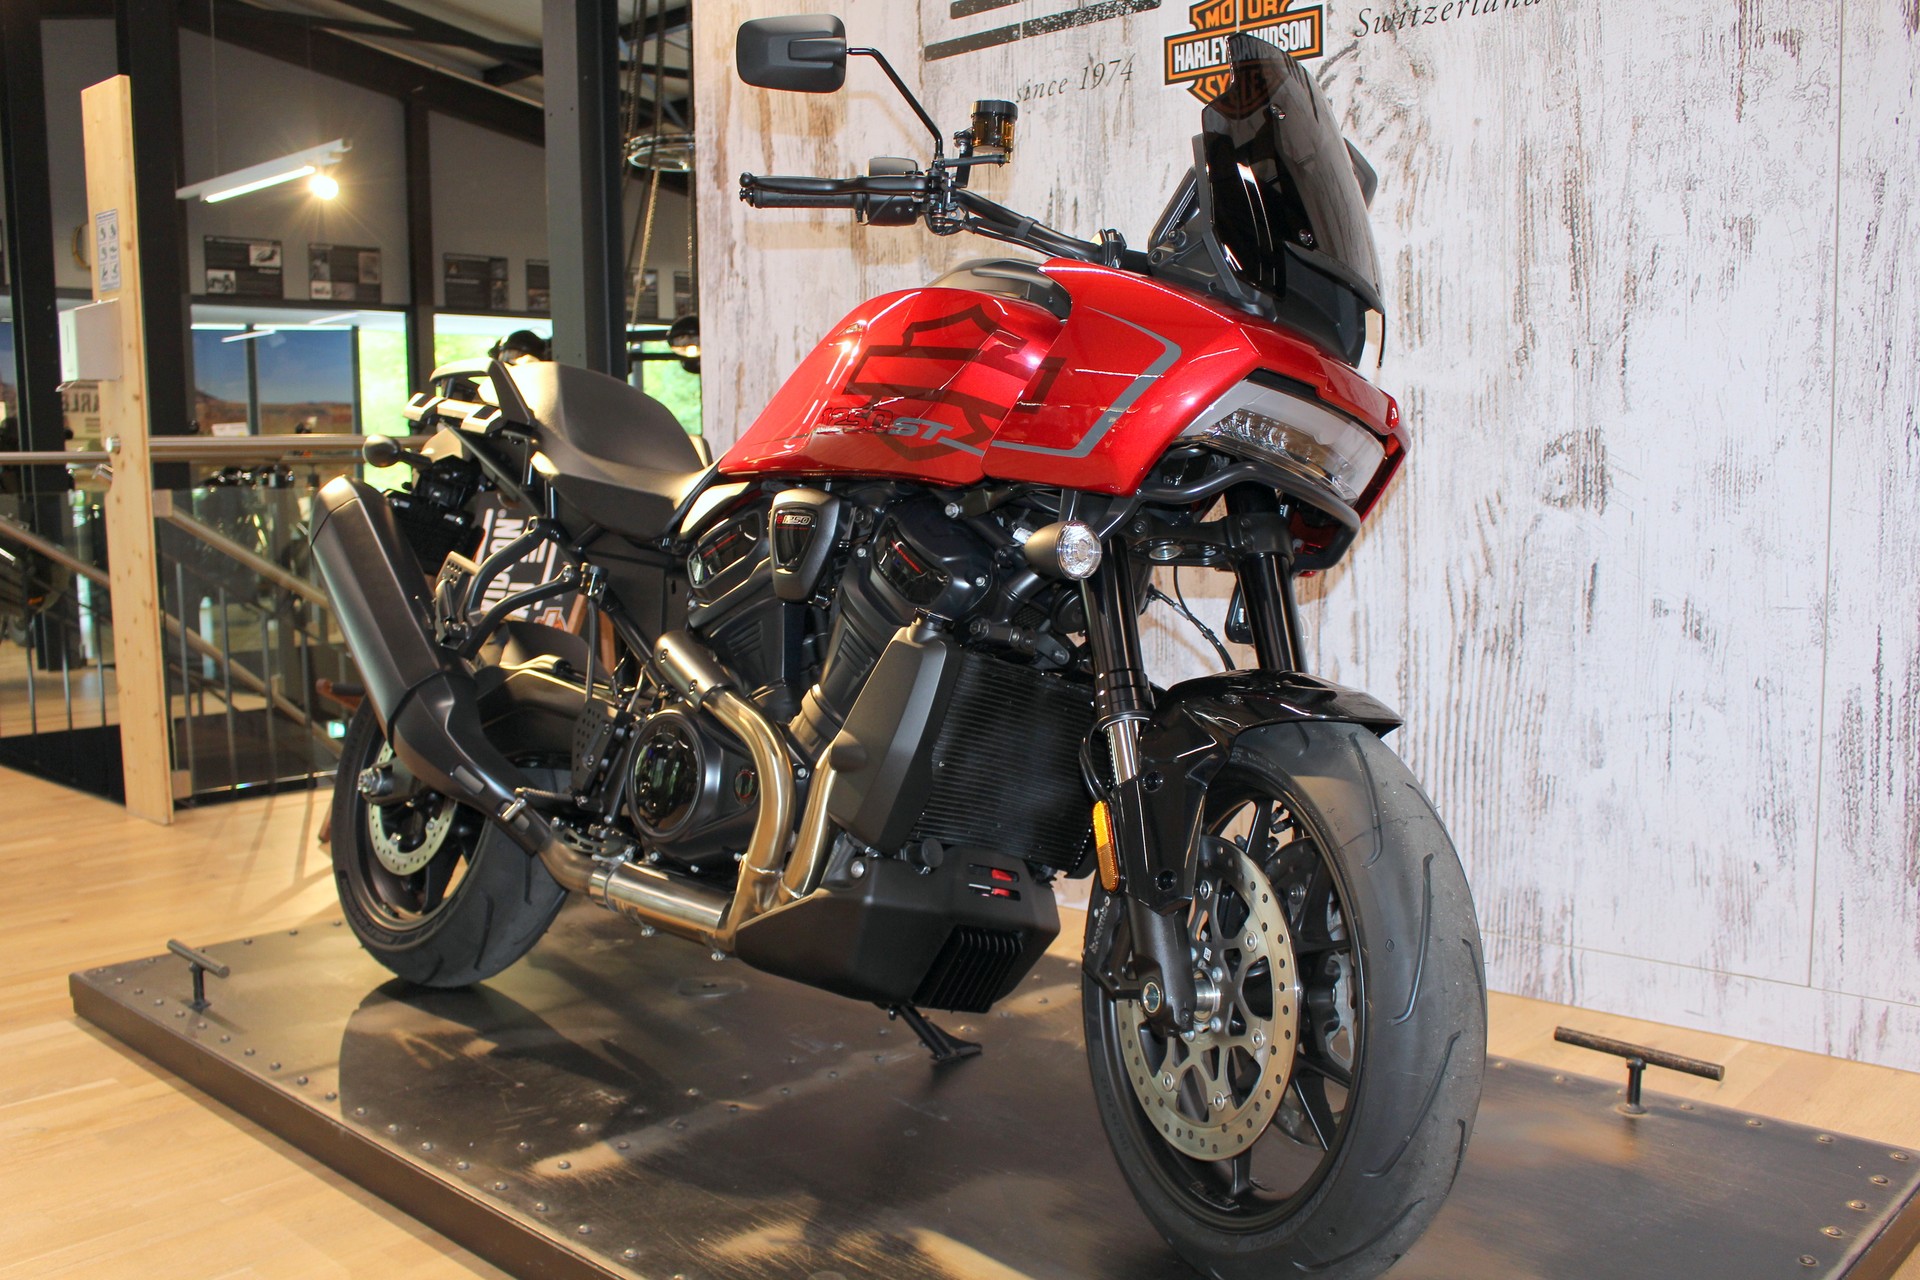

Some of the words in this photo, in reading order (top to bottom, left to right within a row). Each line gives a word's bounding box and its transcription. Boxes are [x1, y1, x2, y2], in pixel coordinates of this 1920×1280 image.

[1355, 0, 1540, 38] Switzerla
[1174, 19, 1312, 73] HARLEYDAVIDSON
[1016, 78, 1068, 103] since
[1080, 53, 1136, 90] 1974
